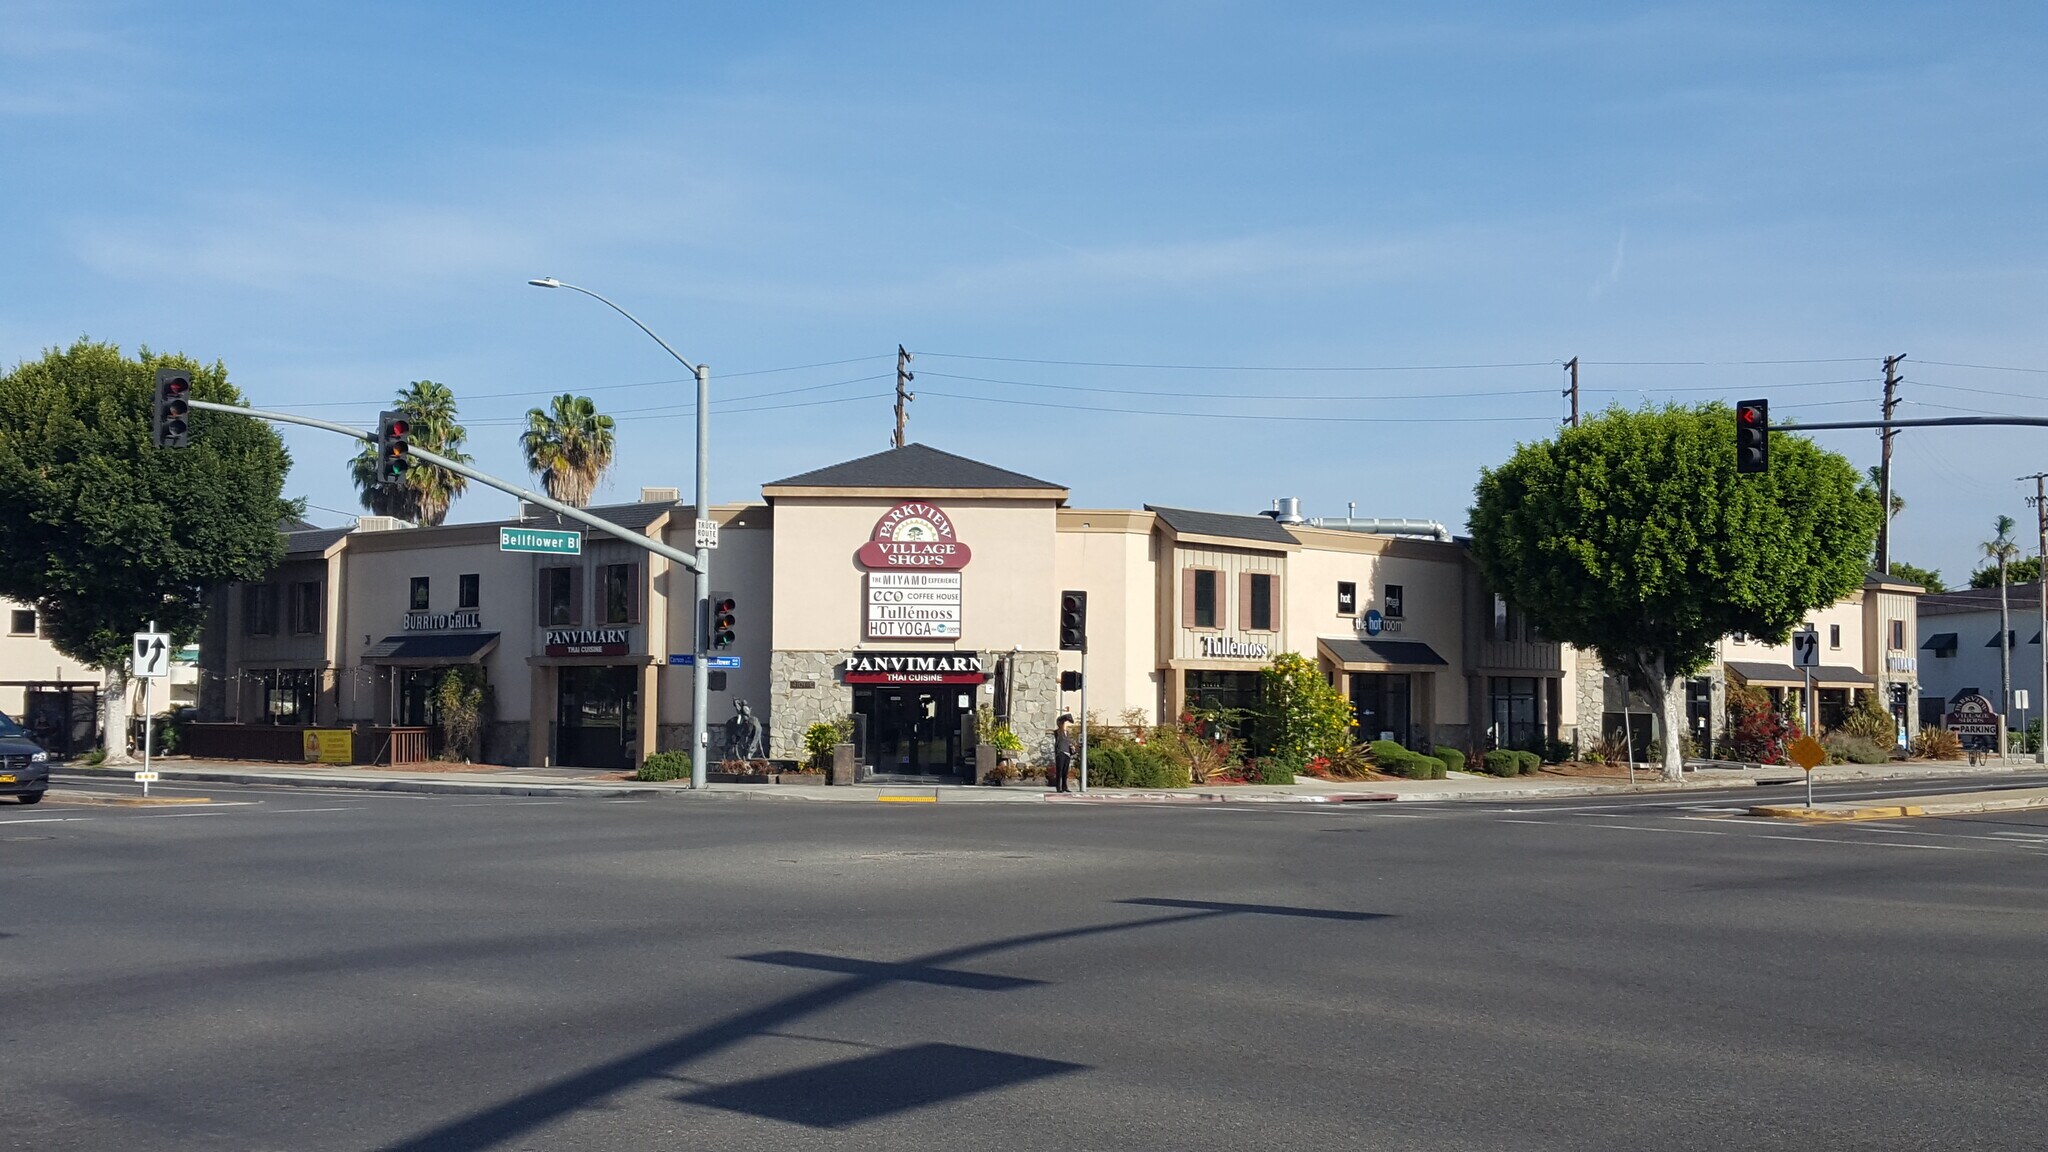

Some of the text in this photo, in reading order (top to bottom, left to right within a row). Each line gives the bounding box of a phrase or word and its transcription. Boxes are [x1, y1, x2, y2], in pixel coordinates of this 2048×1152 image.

[698, 521, 717, 530] TRUCK
[880, 504, 952, 538] PARKVIEW
[698, 530, 717, 538] ROUTE
[502, 533, 579, 549] Bellflower Bl
[879, 543, 956, 555] VILLAGE
[888, 554, 945, 566] SHOPS
[872, 574, 959, 586] THE MIYAMO EXPERIENCE
[873, 590, 959, 603] eco COFFEE HOUSE
[1340, 592, 1352, 604] hot
[877, 604, 953, 620] Tullémoss
[403, 612, 478, 630] BURRITO GRILL
[1355, 616, 1403, 632] the hot room
[870, 621, 895, 636] HOT
[897, 622, 932, 636] YOGA
[546, 629, 626, 644] PANVIMARN
[845, 657, 983, 671] PANVIMARN
[887, 673, 943, 682] THAI CUISINE
[1960, 725, 1996, 733] PARKING
